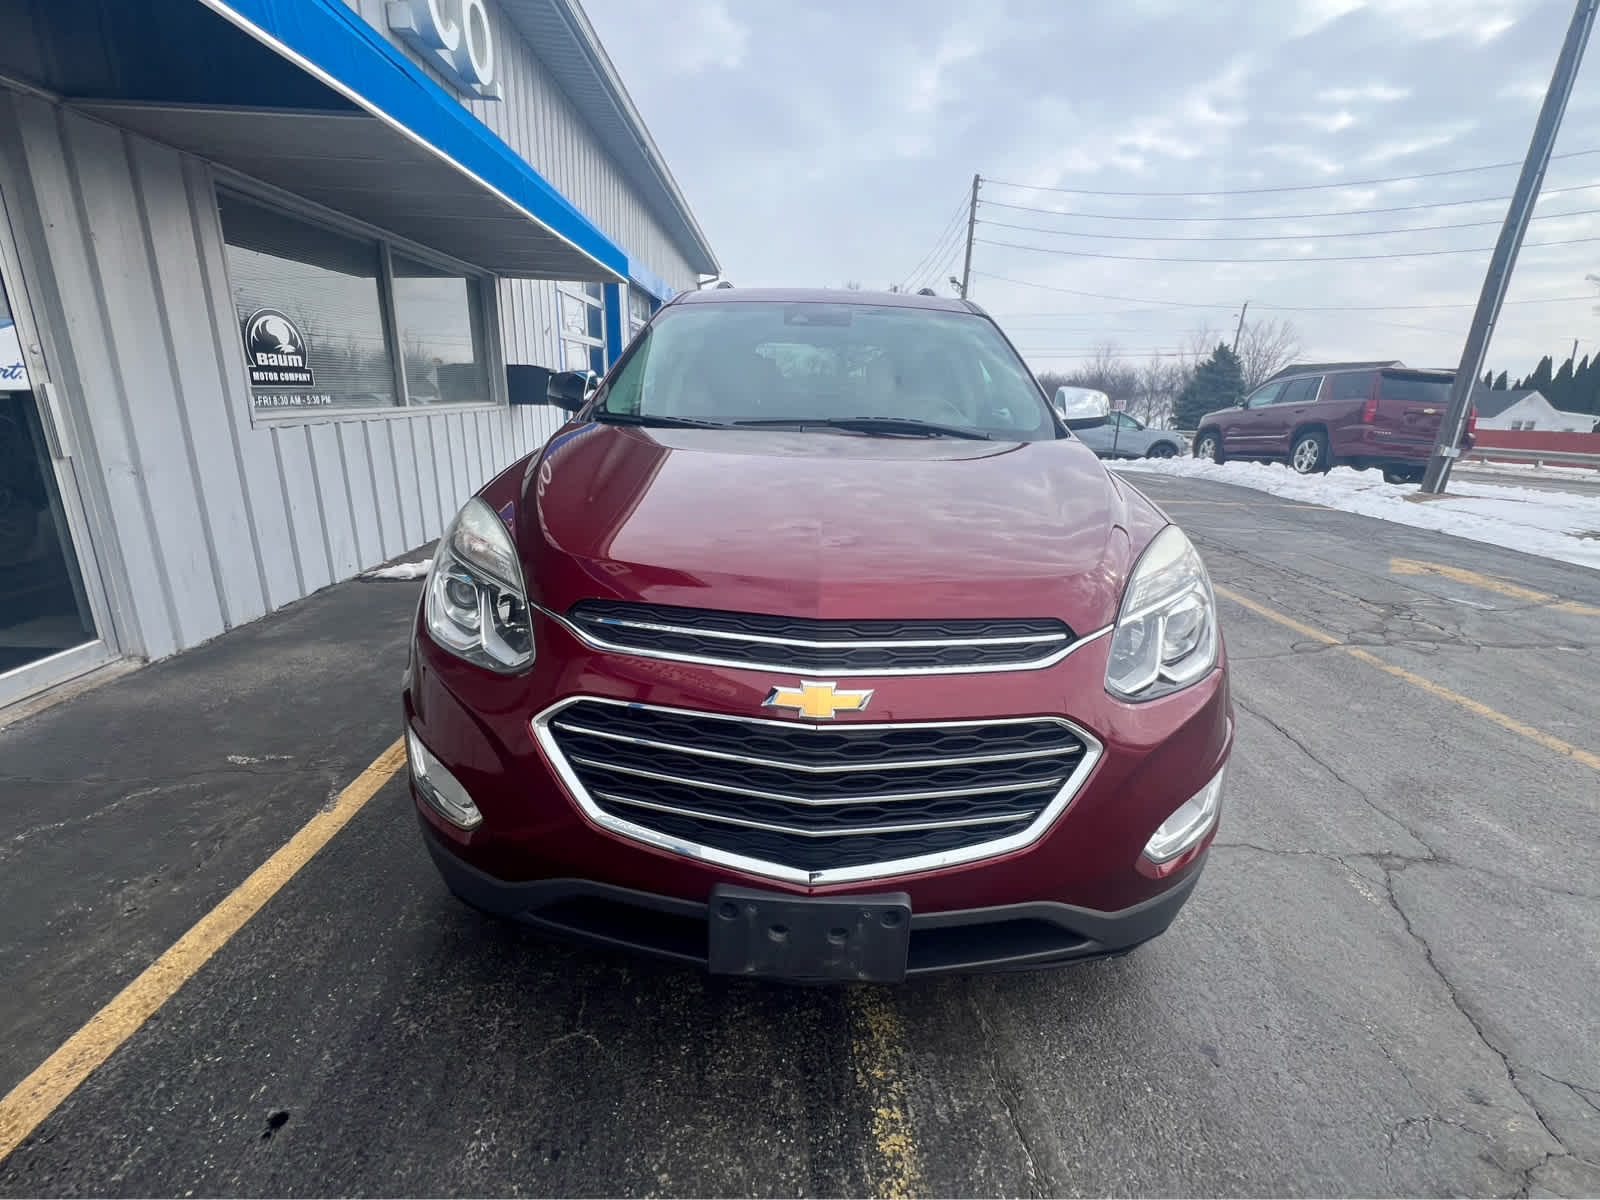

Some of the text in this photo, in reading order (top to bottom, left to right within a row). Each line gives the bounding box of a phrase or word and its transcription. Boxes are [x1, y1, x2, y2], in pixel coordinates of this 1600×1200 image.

[256, 352, 303, 367] Baum
[252, 371, 311, 382] MOTOR COMPANY
[253, 395, 272, 406] -FRI
[290, 395, 301, 405] AM
[321, 395, 332, 404] PM
